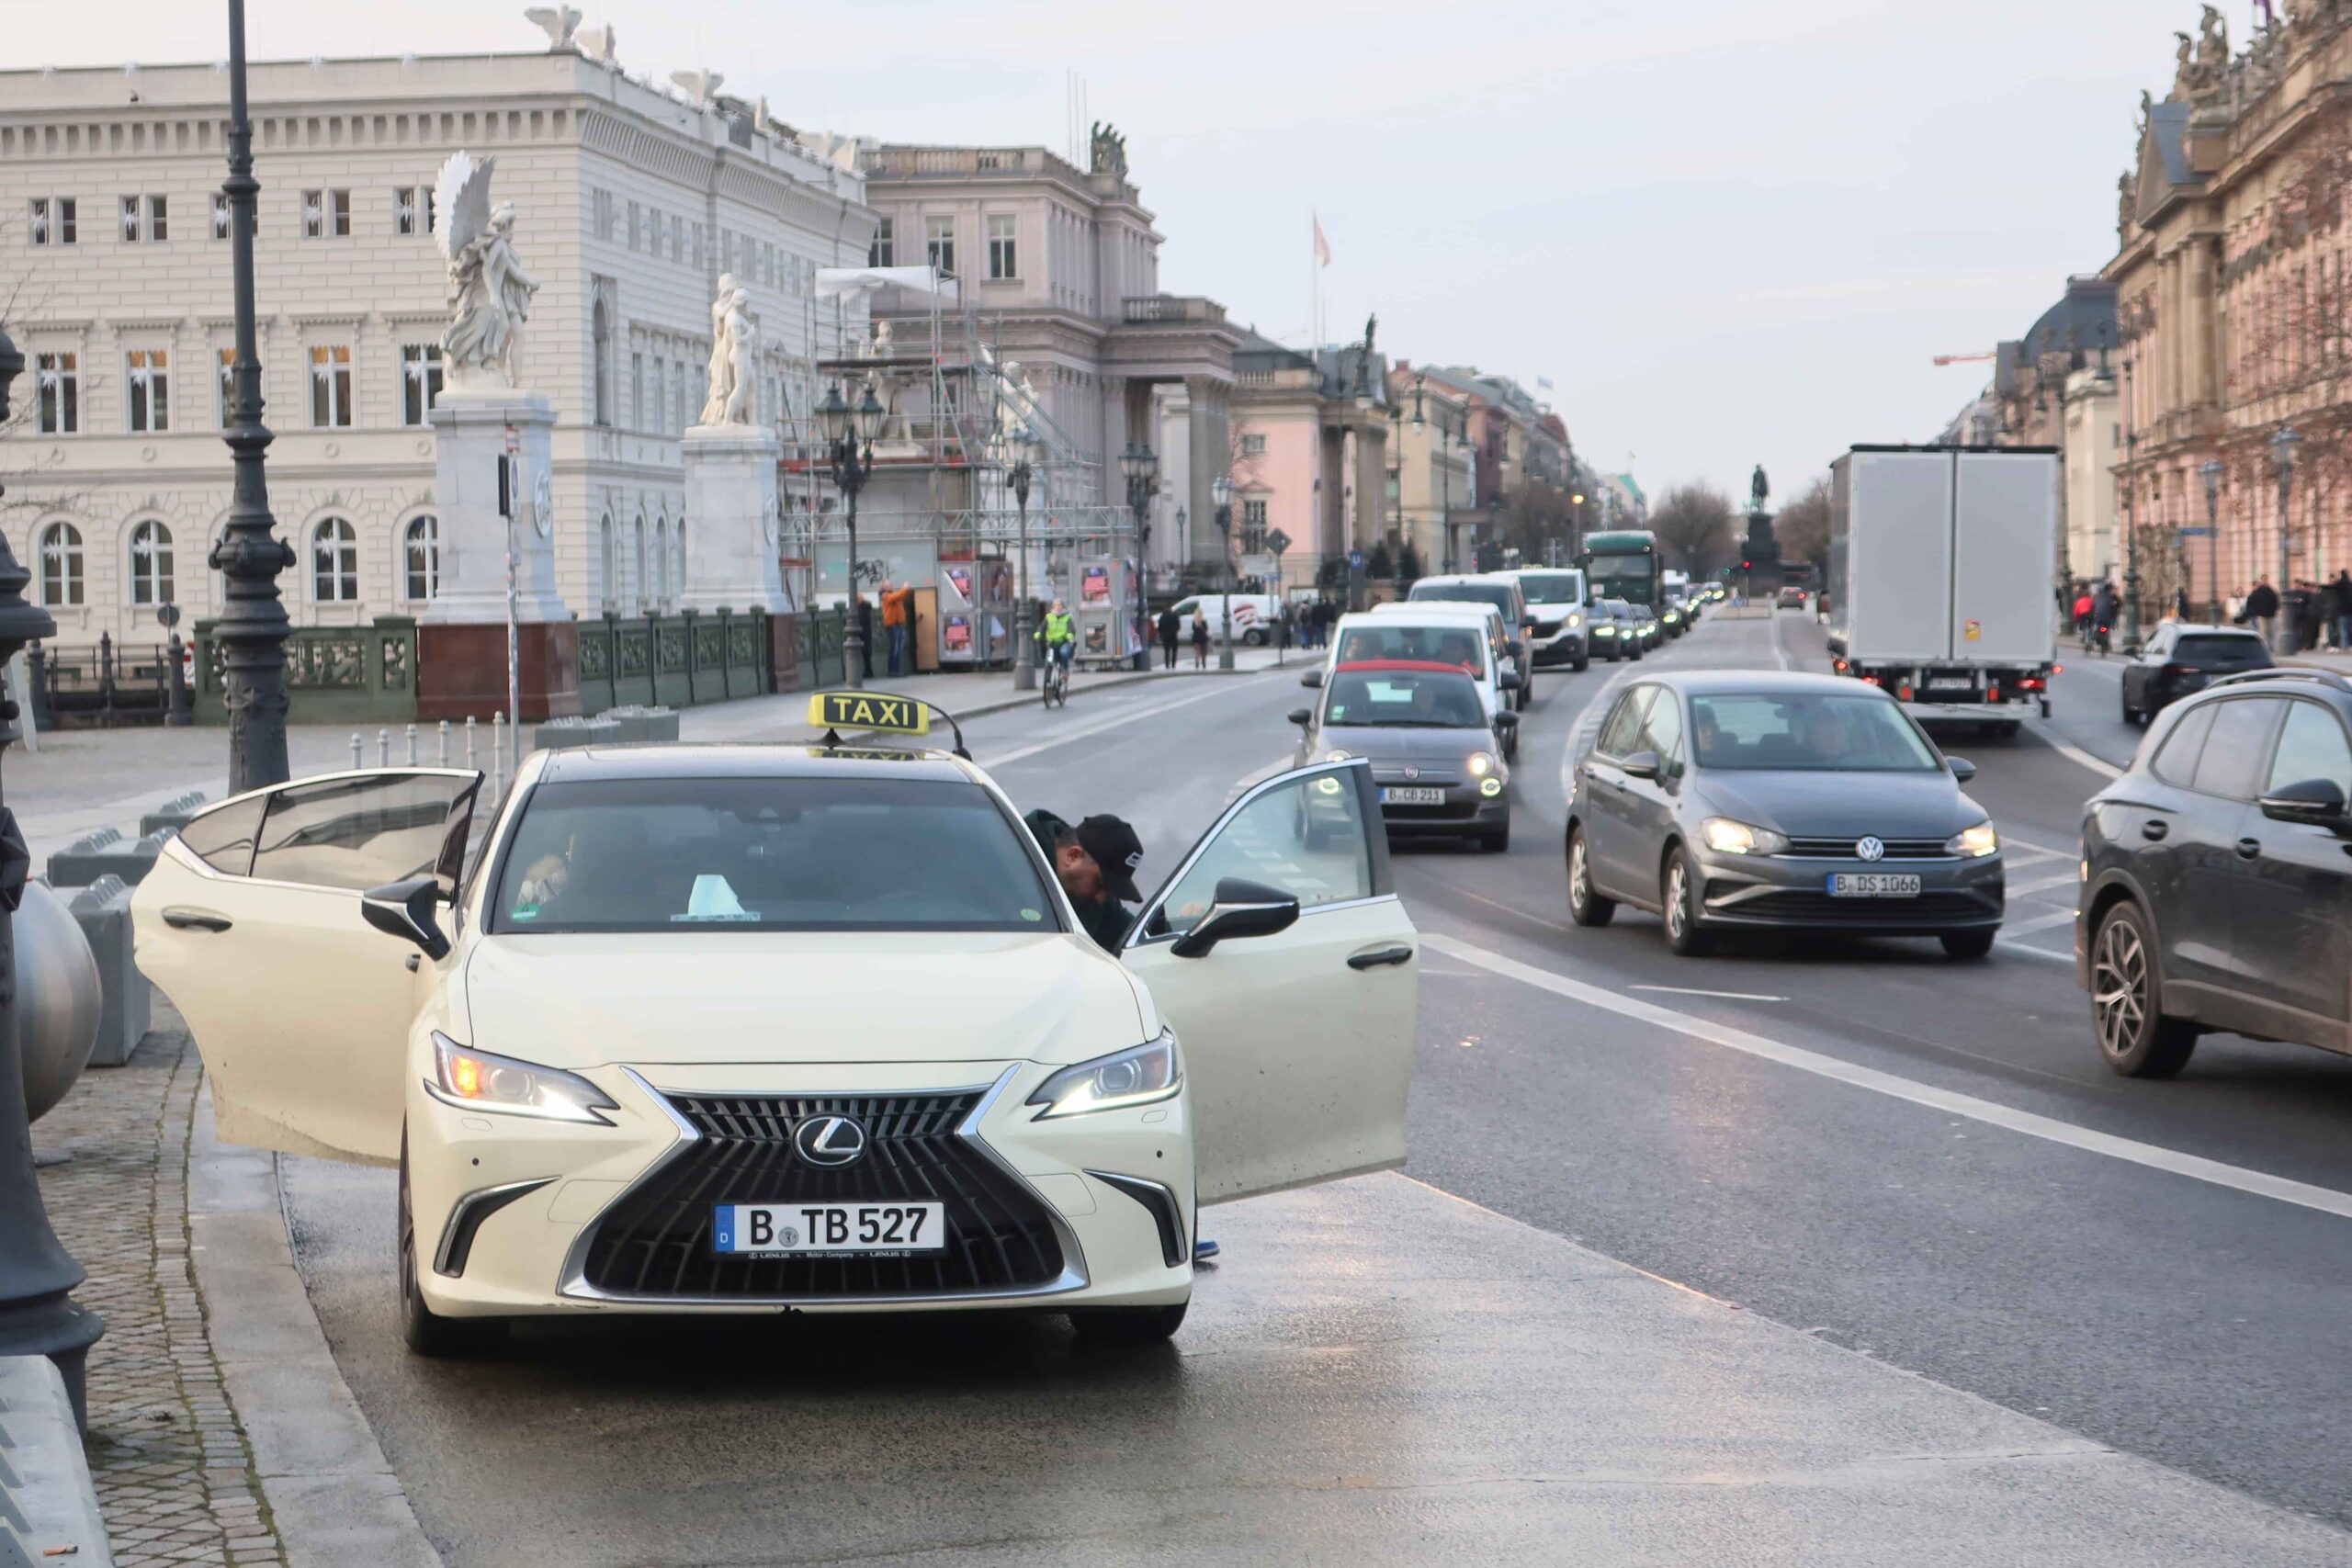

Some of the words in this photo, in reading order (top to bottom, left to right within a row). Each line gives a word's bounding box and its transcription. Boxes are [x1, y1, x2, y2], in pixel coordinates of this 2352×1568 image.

[832, 697, 910, 727] TAXI
[1389, 788, 1396, 800] B
[1420, 789, 1440, 800] 211
[1837, 875, 1847, 891] B
[1857, 876, 1877, 891] DS
[1881, 876, 1919, 891] 1066
[750, 1209, 774, 1246] B
[801, 1208, 849, 1245] TB
[858, 1207, 928, 1244] 527
[719, 1232, 729, 1244] D
